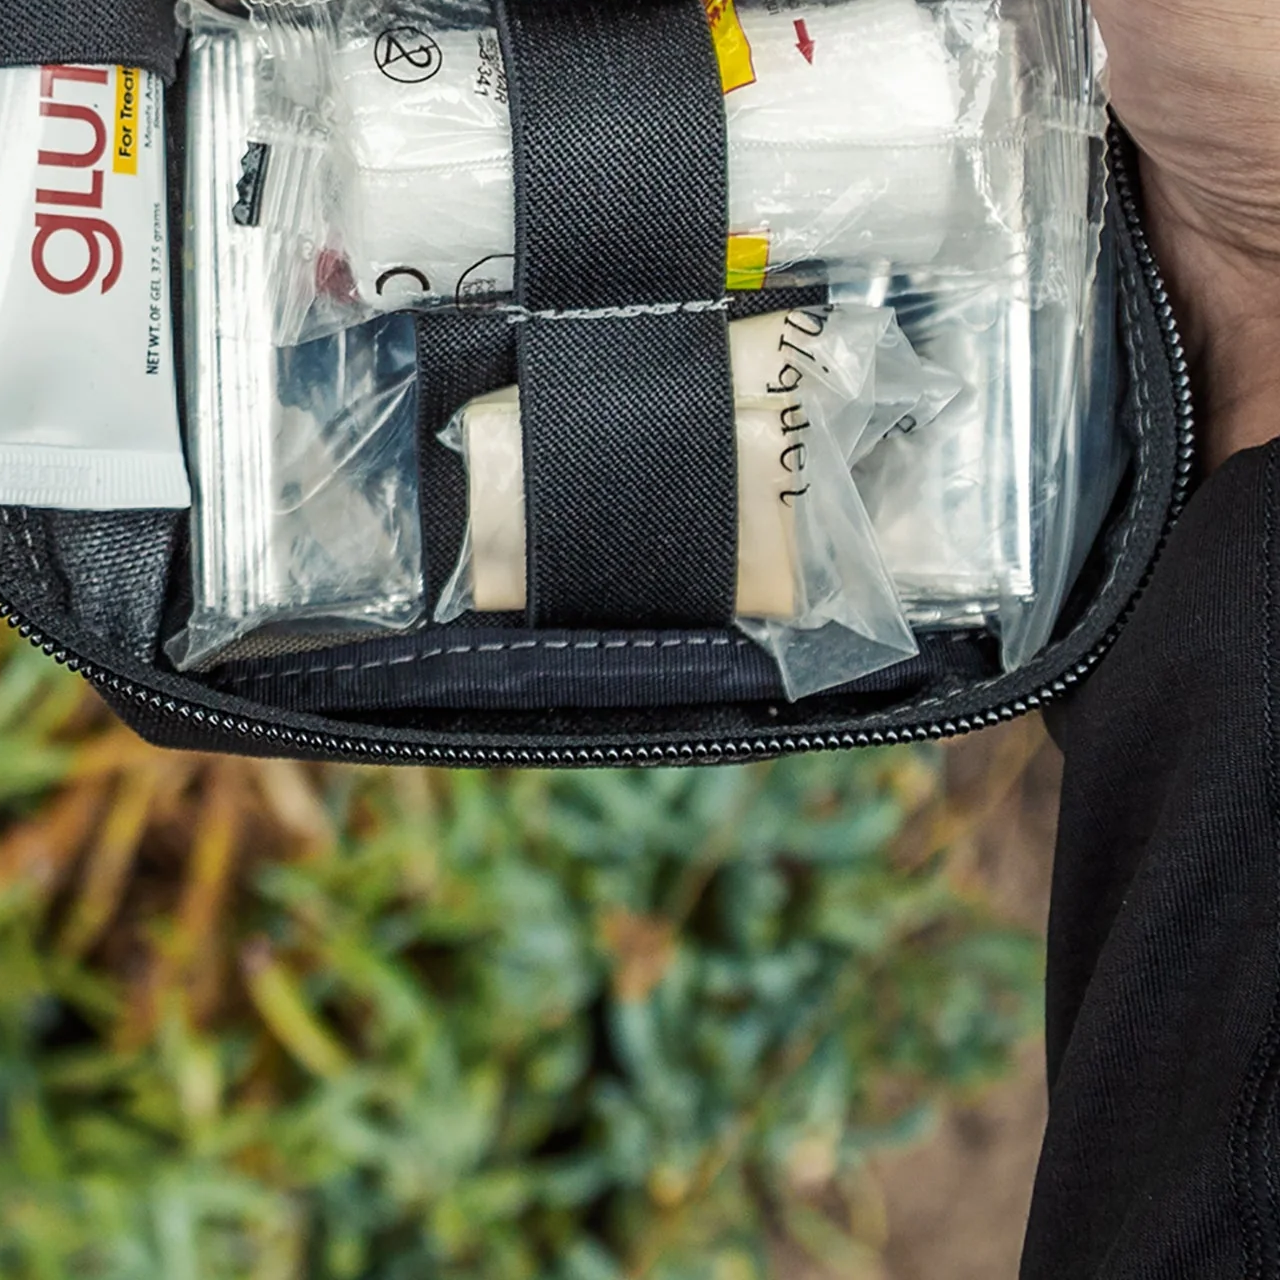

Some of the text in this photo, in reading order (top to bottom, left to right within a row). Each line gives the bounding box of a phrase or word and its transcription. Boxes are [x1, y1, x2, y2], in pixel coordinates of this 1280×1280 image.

[119, 125, 133, 158] For
[153, 202, 162, 243] grams
[151, 278, 162, 302] GEL
[150, 303, 162, 323] OF
